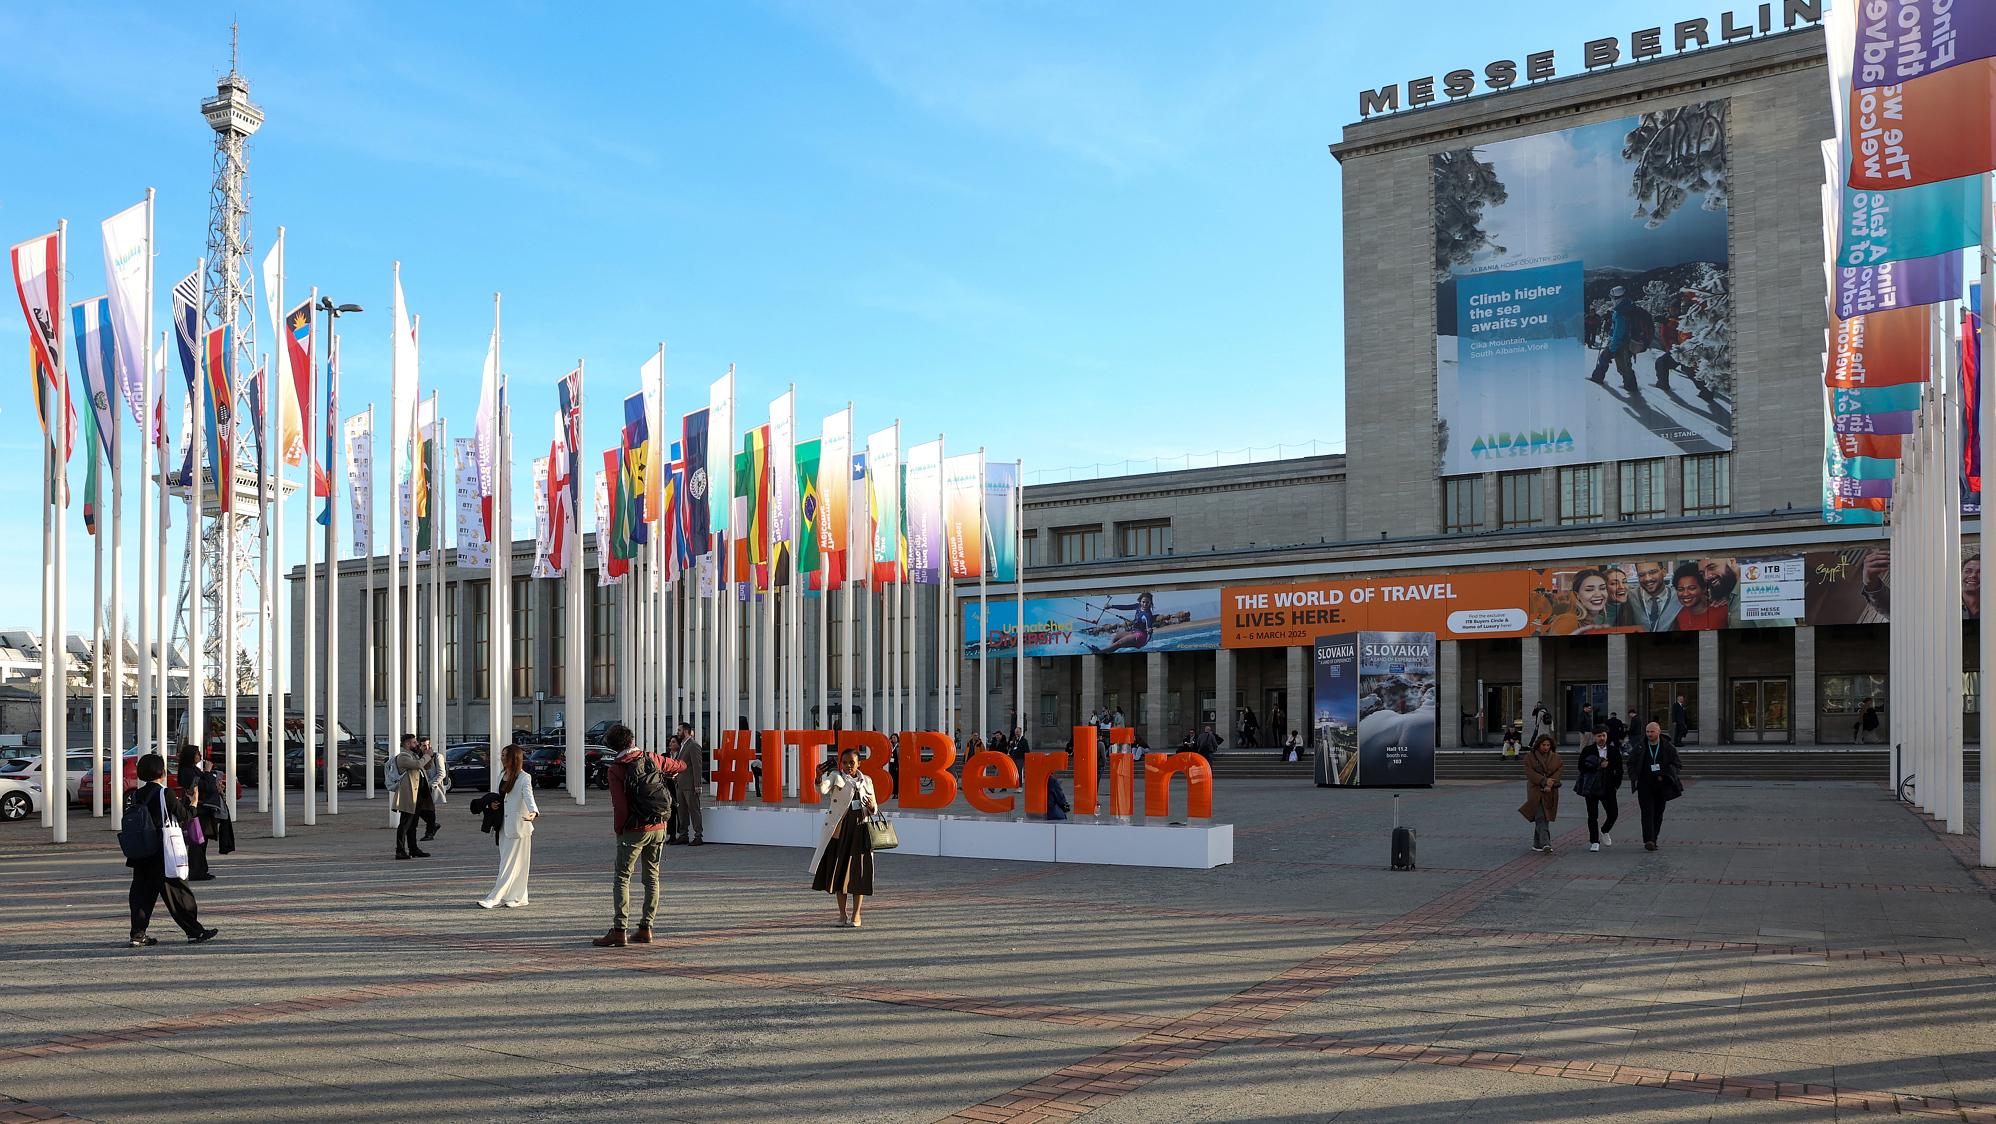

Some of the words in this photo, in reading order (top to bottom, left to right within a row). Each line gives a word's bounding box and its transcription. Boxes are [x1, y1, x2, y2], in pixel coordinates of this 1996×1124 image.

[1359, 49, 1556, 117] MESSE
[1584, 0, 1822, 69] BERLIN
[1470, 264, 1499, 273] ALBANIA
[1470, 291, 1510, 306] Climb
[1514, 284, 1562, 300] higher
[1470, 308, 1493, 320] the
[1497, 305, 1521, 316] sea
[1471, 317, 1518, 333] awaits
[1520, 314, 1548, 328] you
[1489, 337, 1528, 347] Mountain,
[1470, 350, 1494, 359] South
[1471, 426, 1574, 452] ALBANIA
[1764, 565, 1780, 574] ITB
[1235, 593, 1268, 610] THE
[1274, 588, 1344, 609] WORLD
[1349, 586, 1375, 604] OF
[1381, 583, 1457, 602] TRAVEL
[1235, 611, 1285, 628] LIVES
[1292, 609, 1346, 626] HERE.
[1249, 632, 1254, 640] 6
[1256, 631, 1286, 639] MARCH
[1288, 630, 1307, 638] 2025
[1317, 645, 1354, 660] SLOVAKIA
[1365, 645, 1429, 657] SLOVAKIA
